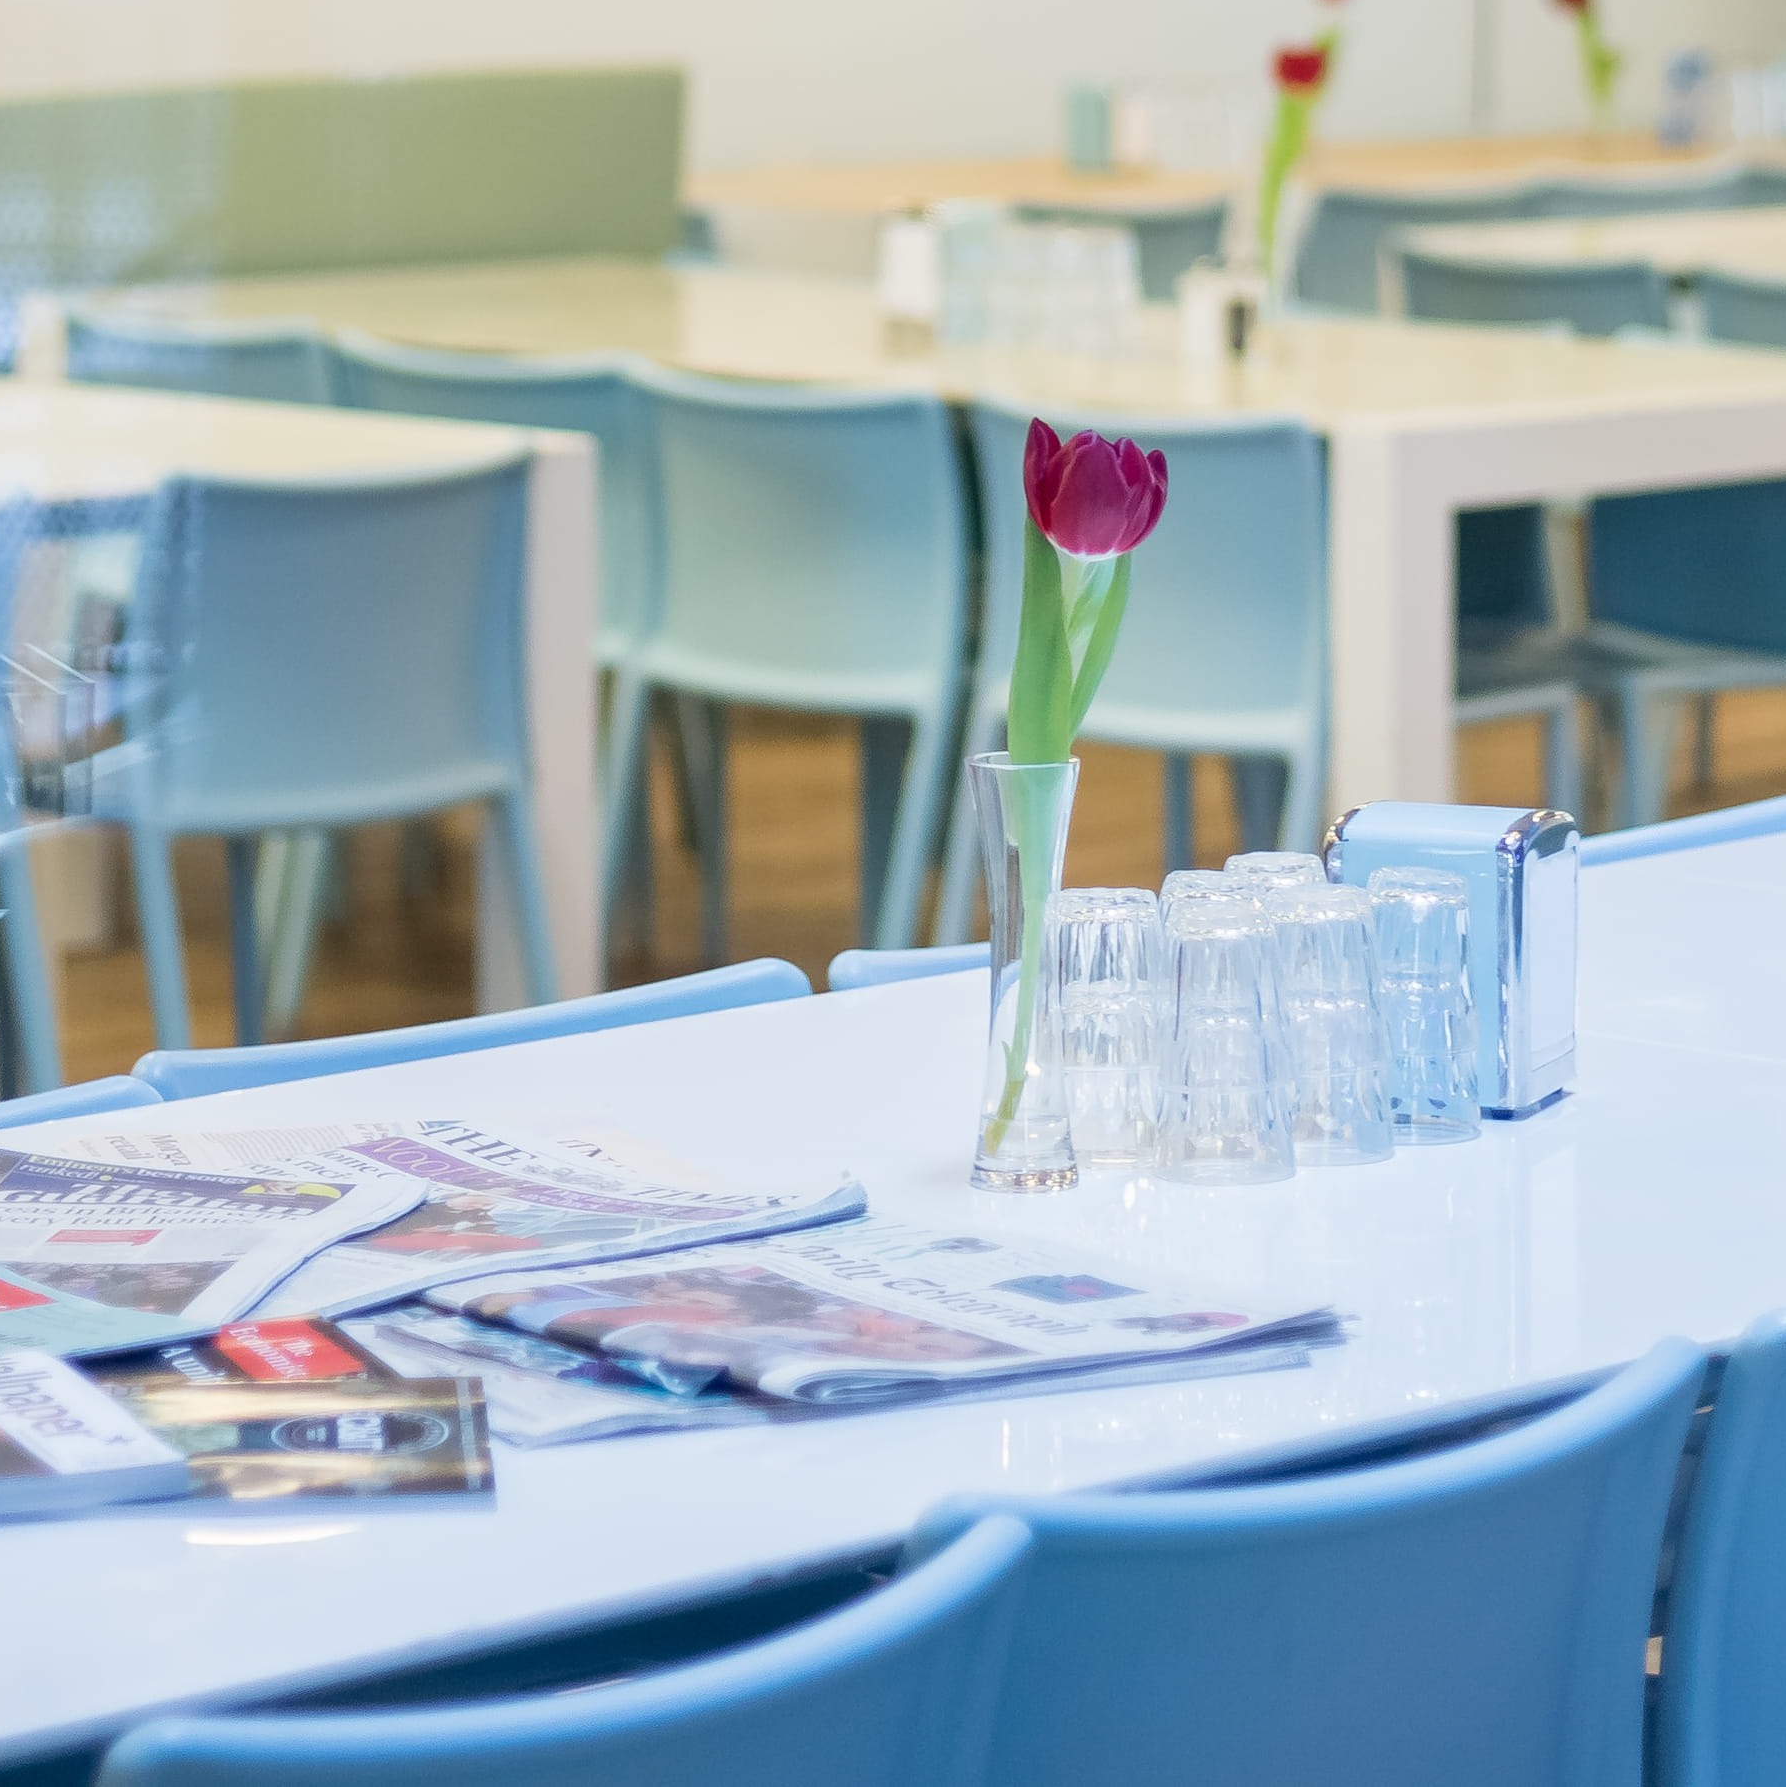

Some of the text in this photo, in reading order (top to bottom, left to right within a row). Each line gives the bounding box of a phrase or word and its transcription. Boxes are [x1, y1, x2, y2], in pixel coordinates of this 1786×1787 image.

[418, 1125, 537, 1166] THE
[135, 1168, 185, 1180] best
[184, 1173, 251, 1185] songs
[65, 1205, 95, 1215] in
[101, 1205, 220, 1217] Britain
[70, 1213, 134, 1225] four
[229, 1326, 308, 1379] Economist
[283, 1337, 314, 1357] The
